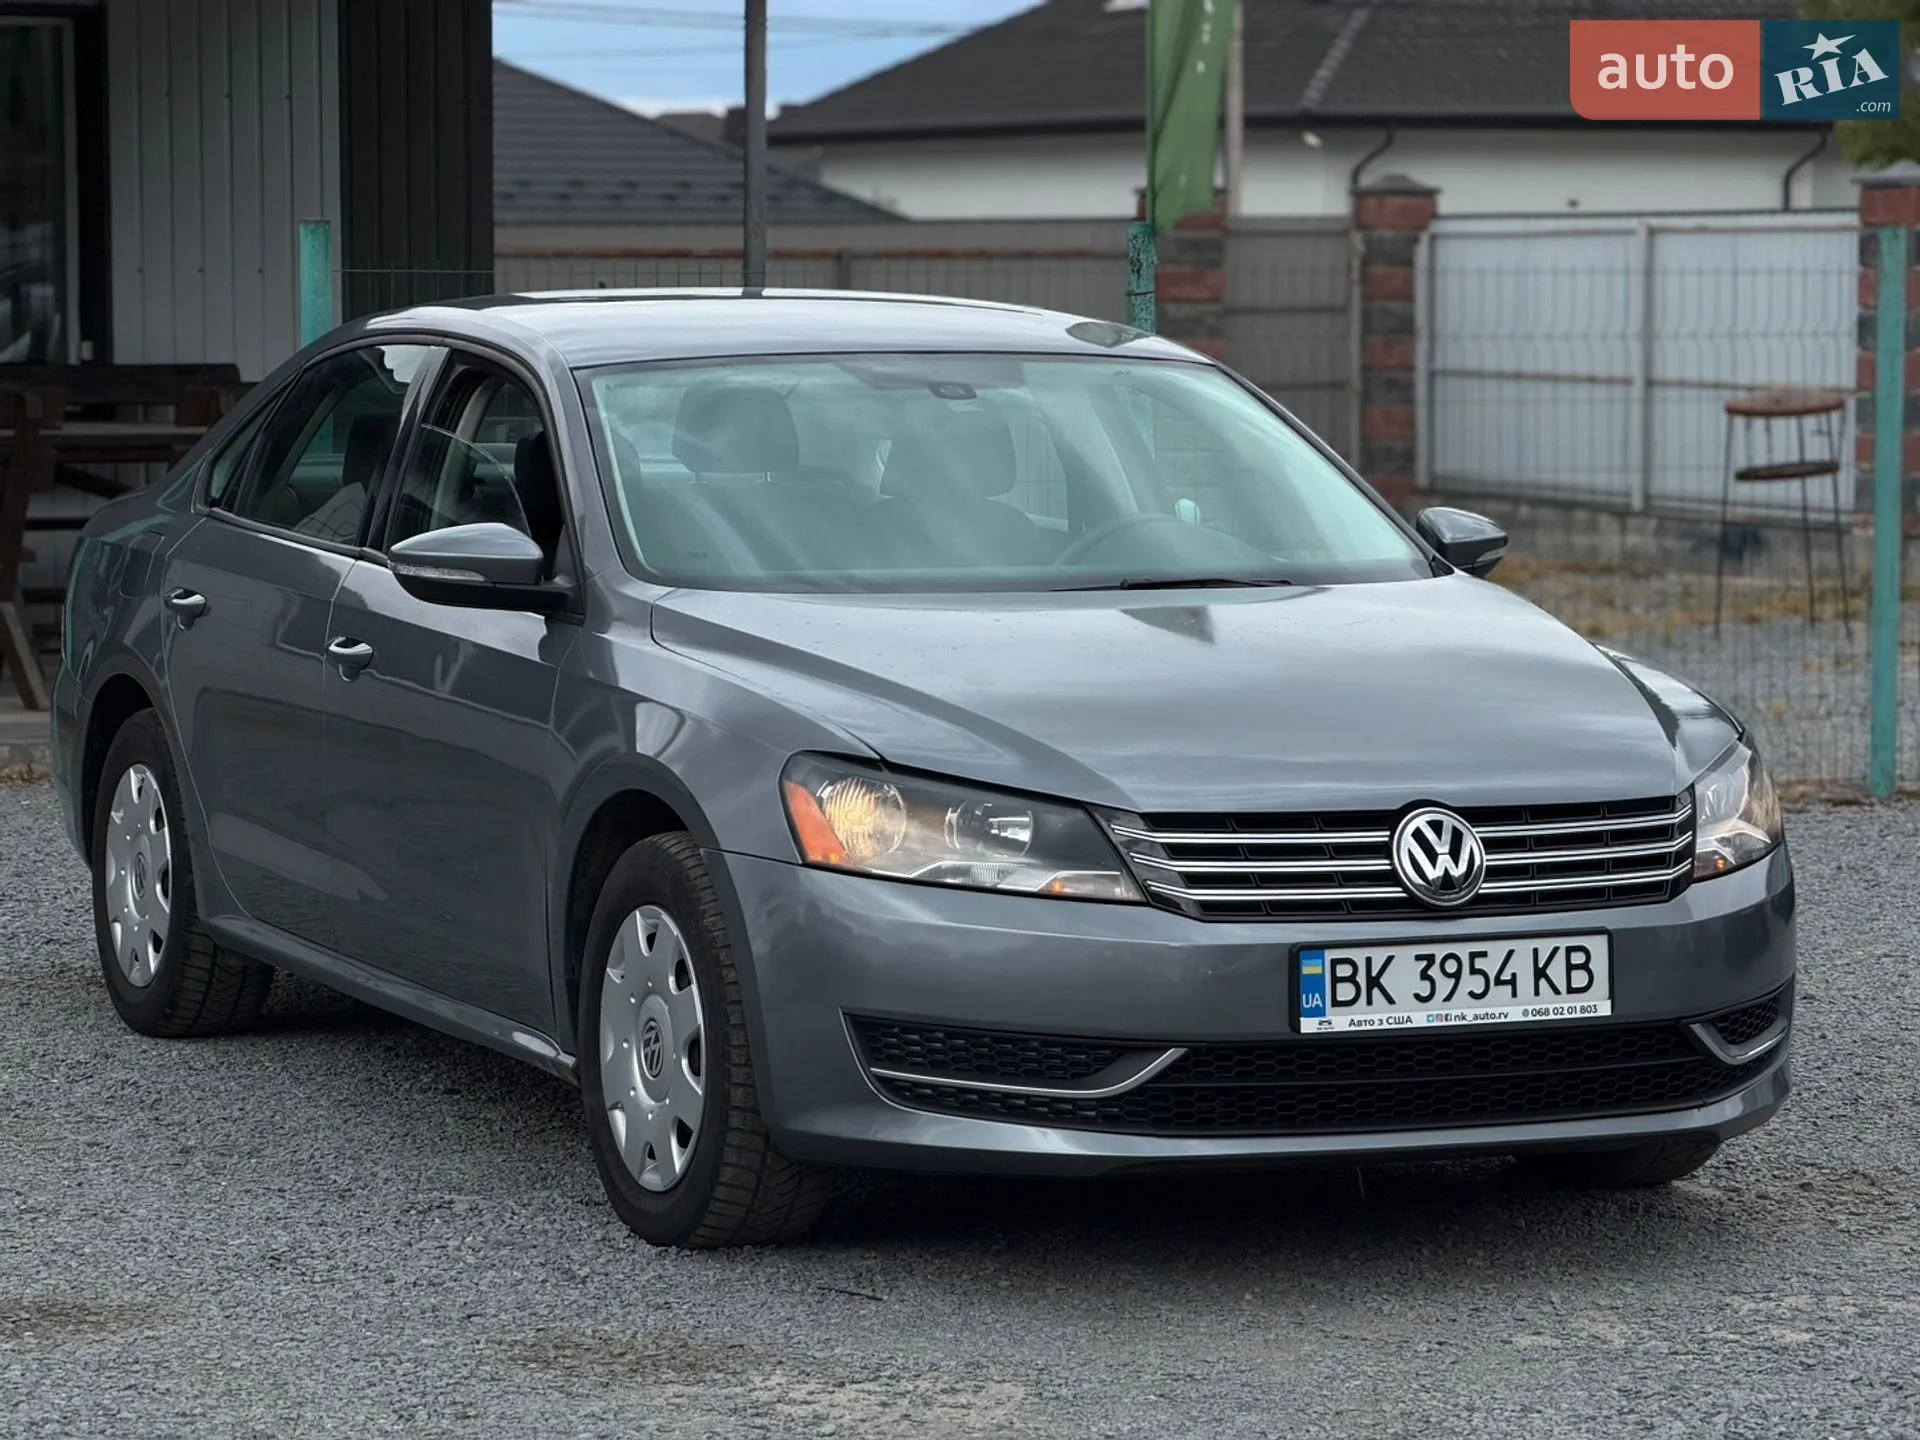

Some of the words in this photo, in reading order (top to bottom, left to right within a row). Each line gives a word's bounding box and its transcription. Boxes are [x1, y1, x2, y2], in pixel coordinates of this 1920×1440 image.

[1330, 955, 1397, 1008] BK
[1413, 948, 1518, 1003] 3954
[1533, 945, 1595, 997] KB
[1302, 993, 1323, 1008] UA
[1531, 1007, 1552, 1018] 068
[1553, 1006, 1566, 1016] 02
[1580, 1004, 1598, 1015] 803
[1348, 1017, 1375, 1028] Авто
[1386, 1014, 1413, 1025] США
